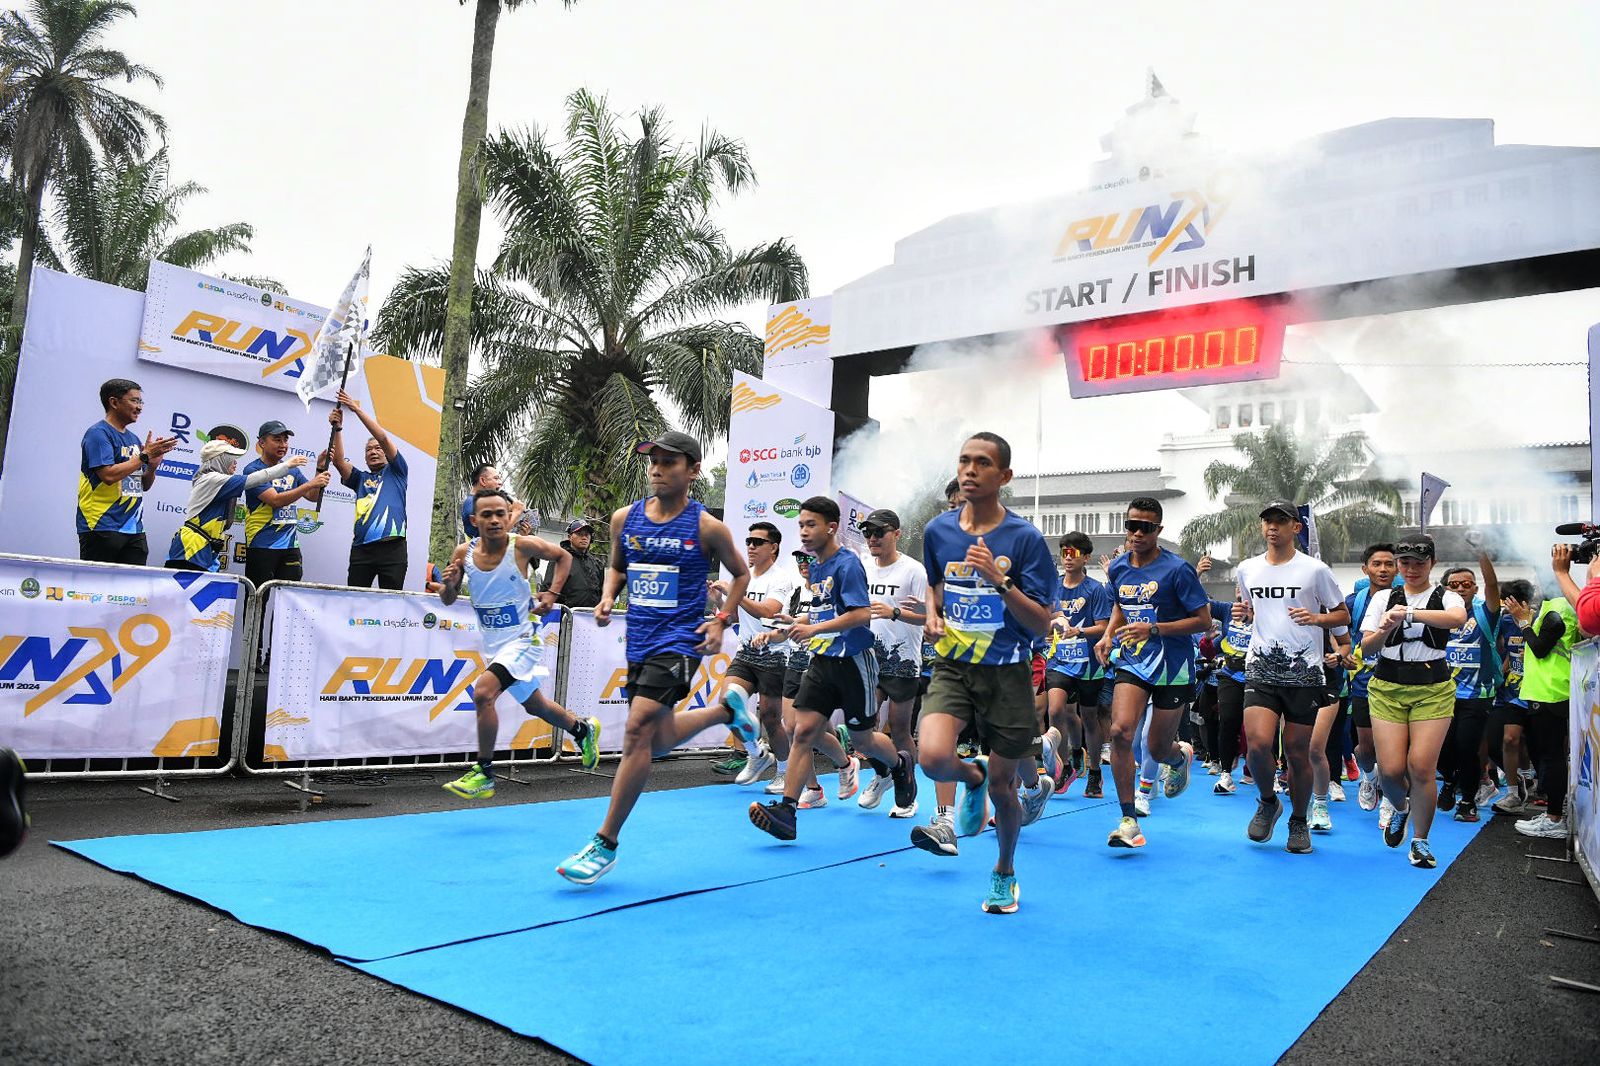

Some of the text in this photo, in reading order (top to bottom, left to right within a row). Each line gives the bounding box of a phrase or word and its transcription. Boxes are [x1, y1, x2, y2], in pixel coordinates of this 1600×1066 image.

[1025, 254, 1256, 315] START / FINISH
[172, 310, 298, 360] RUN
[290, 447, 316, 458] TIRTA
[753, 445, 821, 461] SCG bank bjb
[632, 580, 669, 596] 0397
[1250, 586, 1302, 599] RIOT
[952, 602, 992, 619] 0723
[482, 613, 512, 625] 0739
[1449, 651, 1474, 661] 0124
[320, 656, 468, 695] RUN
[16, 682, 41, 691] 2024
[319, 694, 337, 702] HARI
[338, 694, 361, 702] BAKTI
[362, 694, 401, 702] PEKERJAAN
